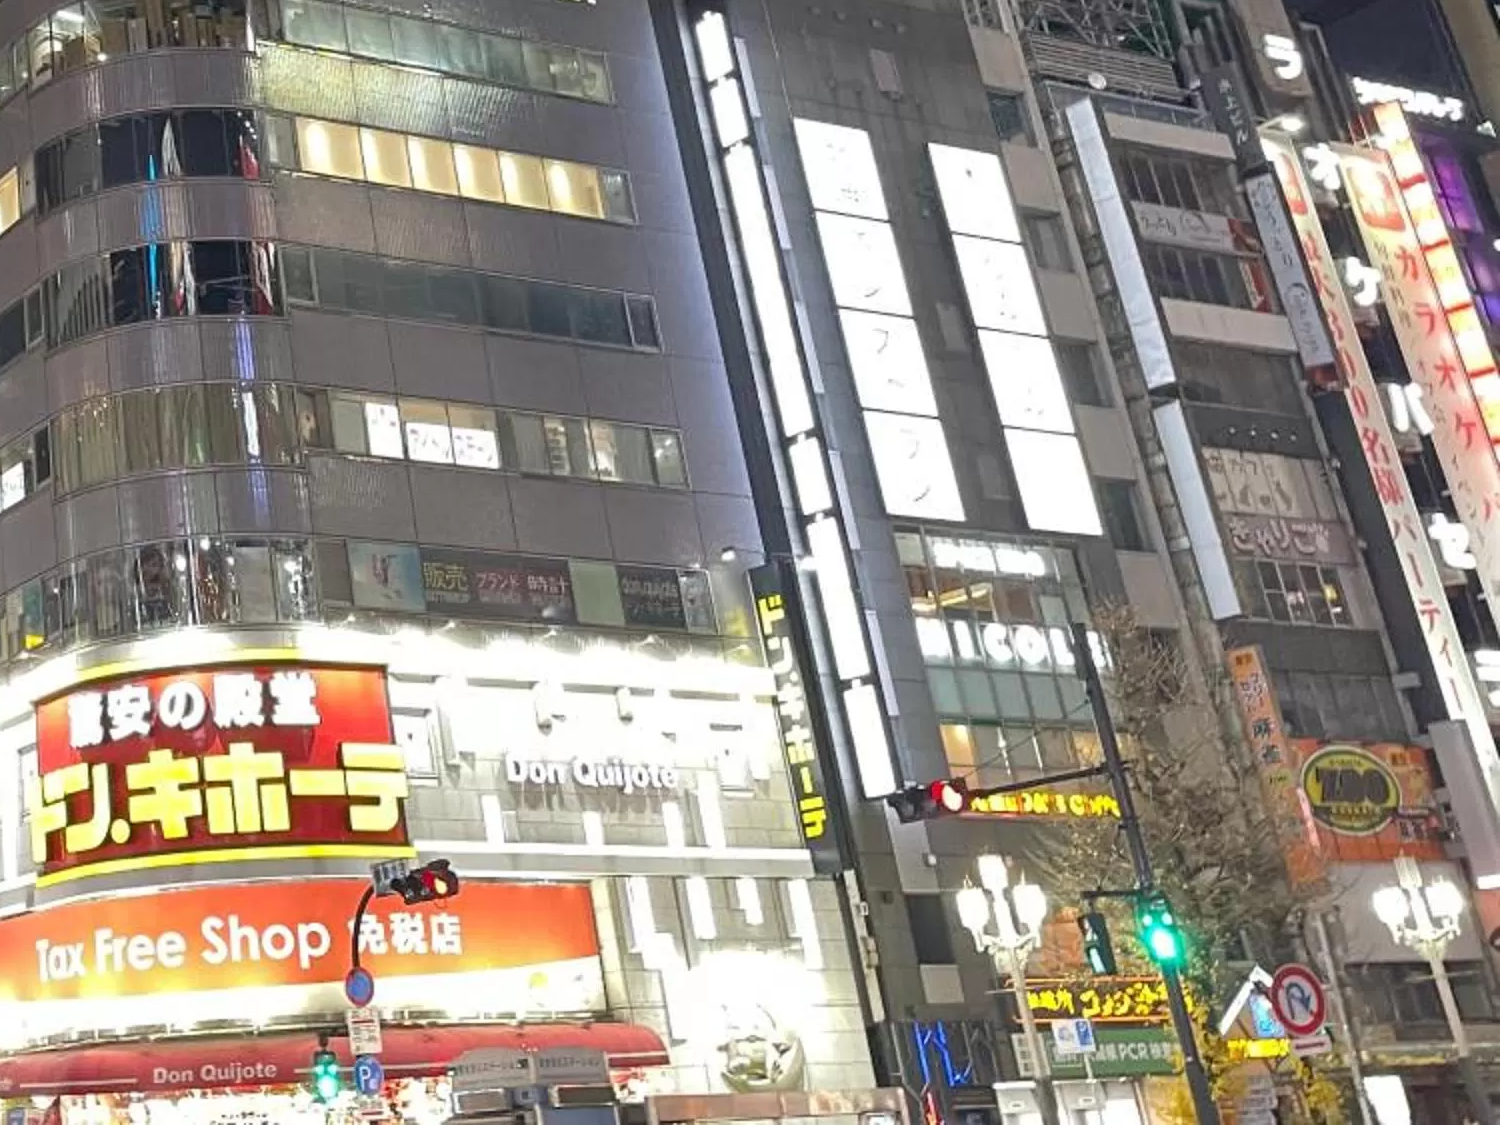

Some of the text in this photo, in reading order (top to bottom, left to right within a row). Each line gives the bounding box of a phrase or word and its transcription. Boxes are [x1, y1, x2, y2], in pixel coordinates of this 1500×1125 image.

[423, 561, 469, 592] 販売
[528, 574, 570, 597] 時計
[506, 754, 679, 794] Don Quijote
[36, 914, 332, 982] Tax Free Shop
[349, 912, 463, 956] 免税店
[153, 1061, 278, 1086] Don Quijote
